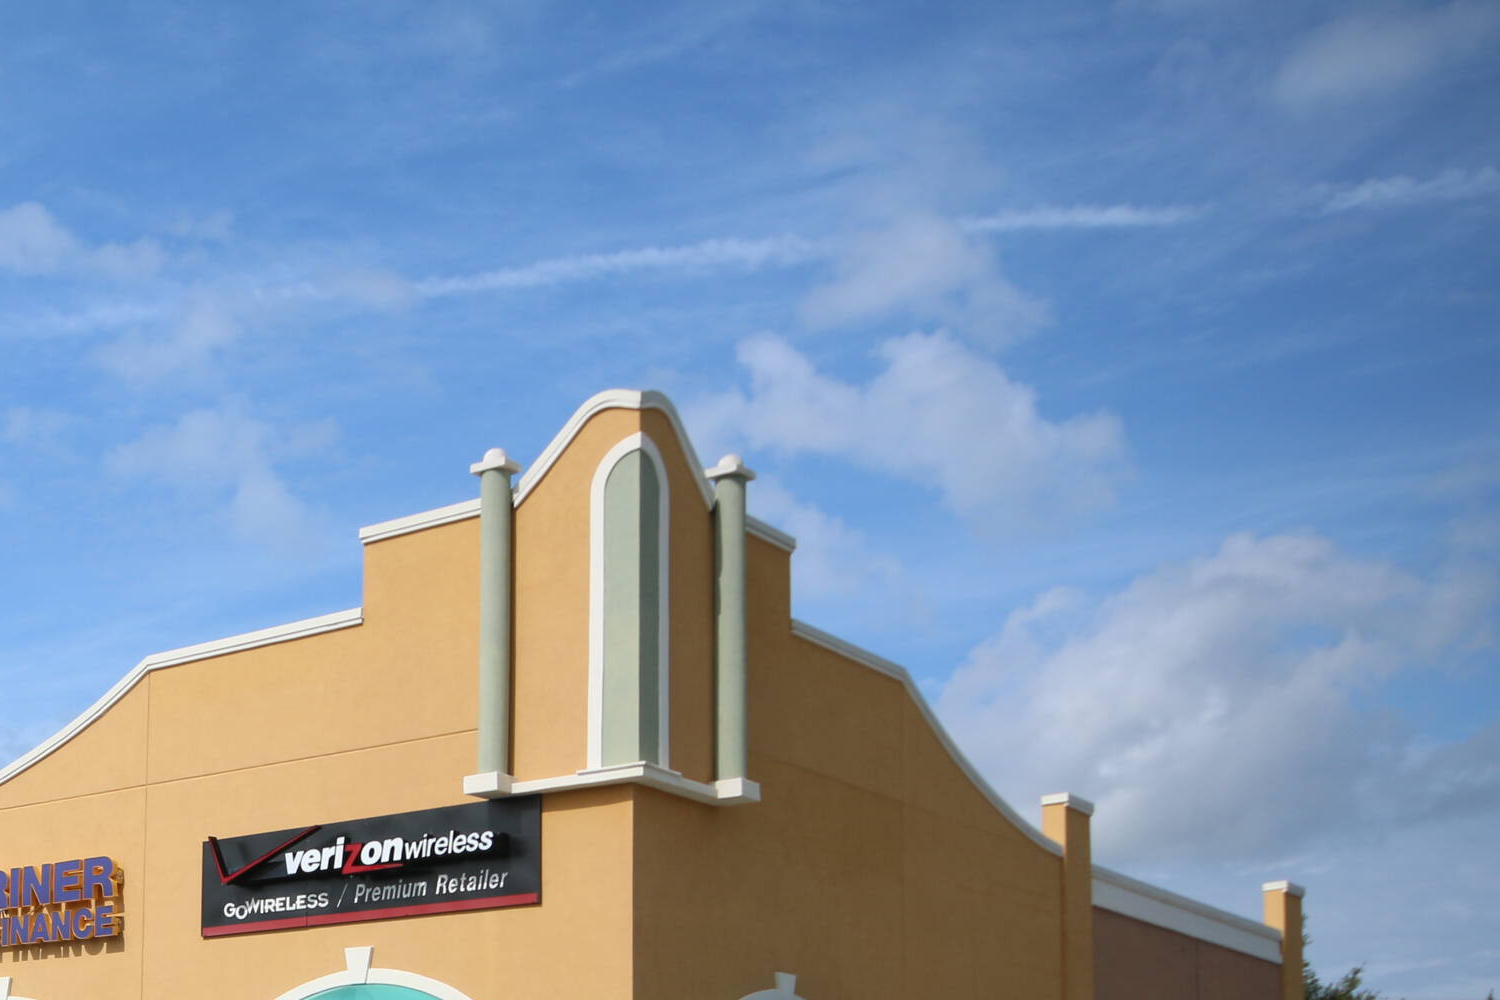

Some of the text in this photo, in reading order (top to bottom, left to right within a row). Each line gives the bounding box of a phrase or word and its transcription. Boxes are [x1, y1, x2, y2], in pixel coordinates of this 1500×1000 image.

[284, 829, 495, 875] verizon wireless
[353, 879, 427, 904] Premium
[435, 869, 509, 896] Retailer
